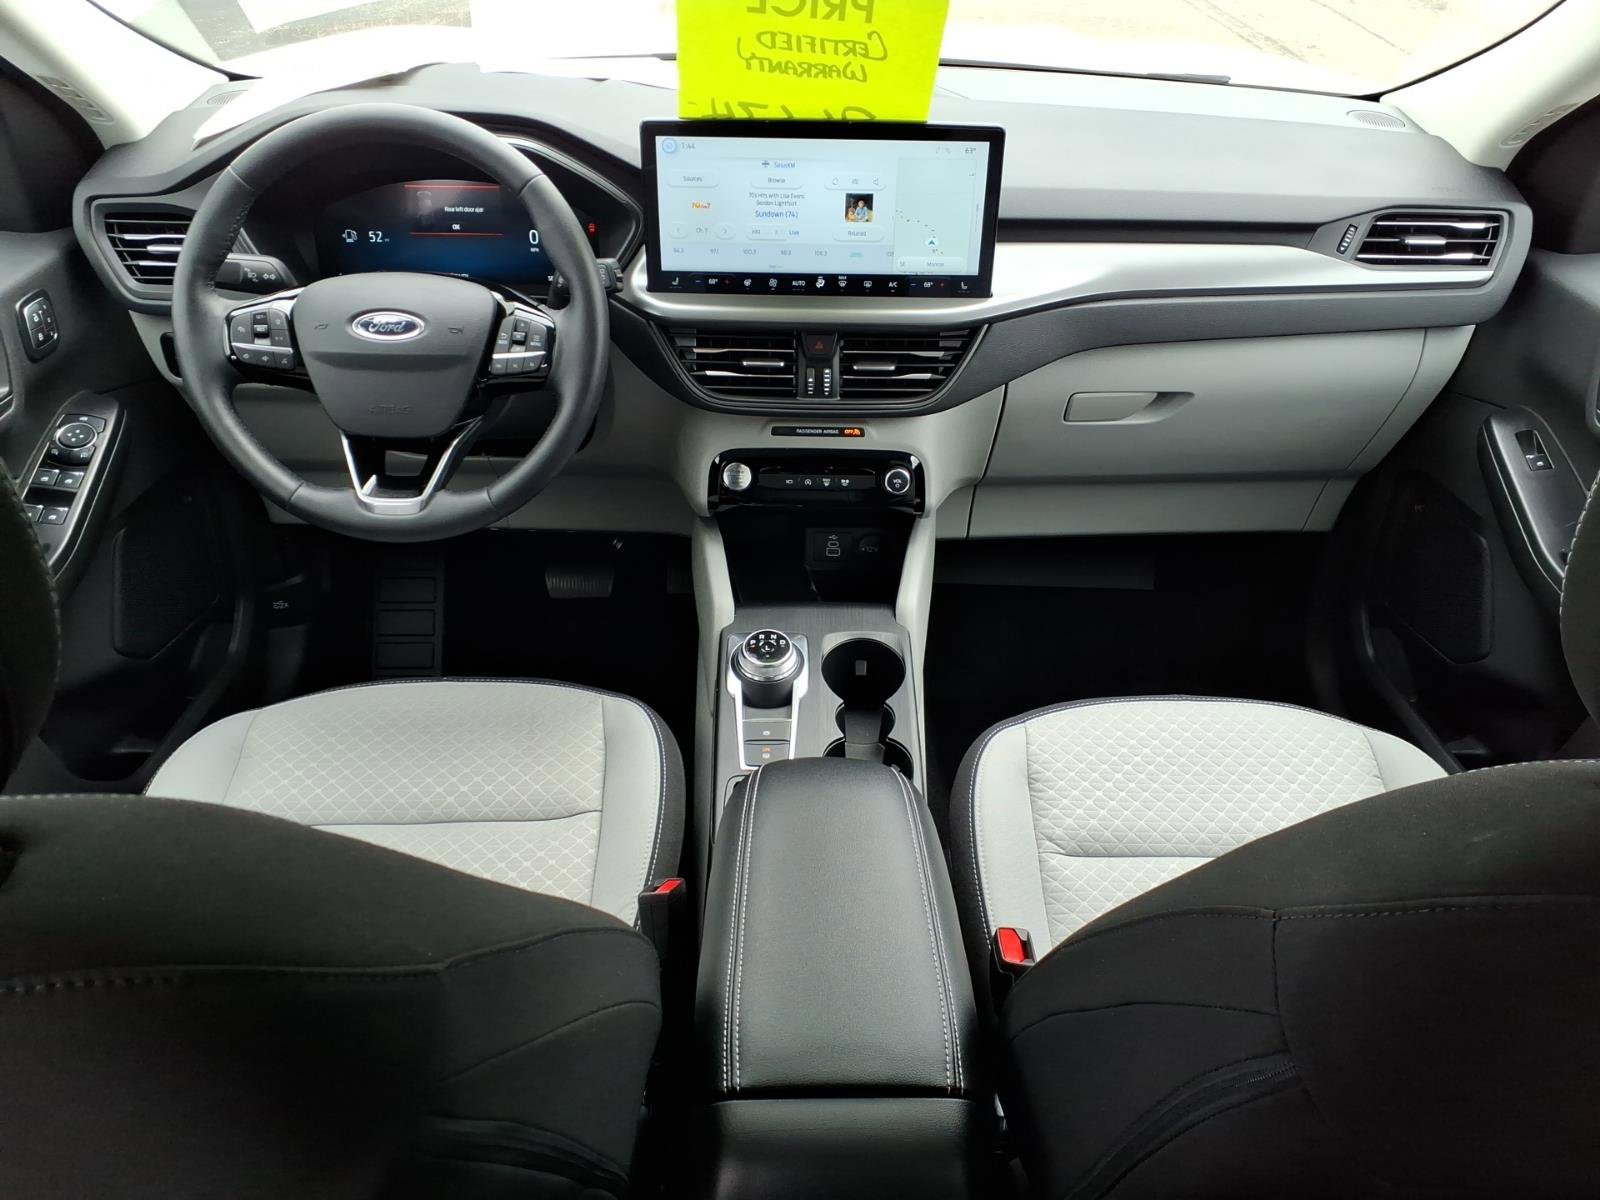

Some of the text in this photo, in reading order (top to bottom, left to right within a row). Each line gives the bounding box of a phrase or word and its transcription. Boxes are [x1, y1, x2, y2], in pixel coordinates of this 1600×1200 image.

[755, 210, 784, 218] Sundown
[368, 231, 383, 243] 52
[529, 229, 539, 245] 0
[368, 319, 406, 333] Ford
